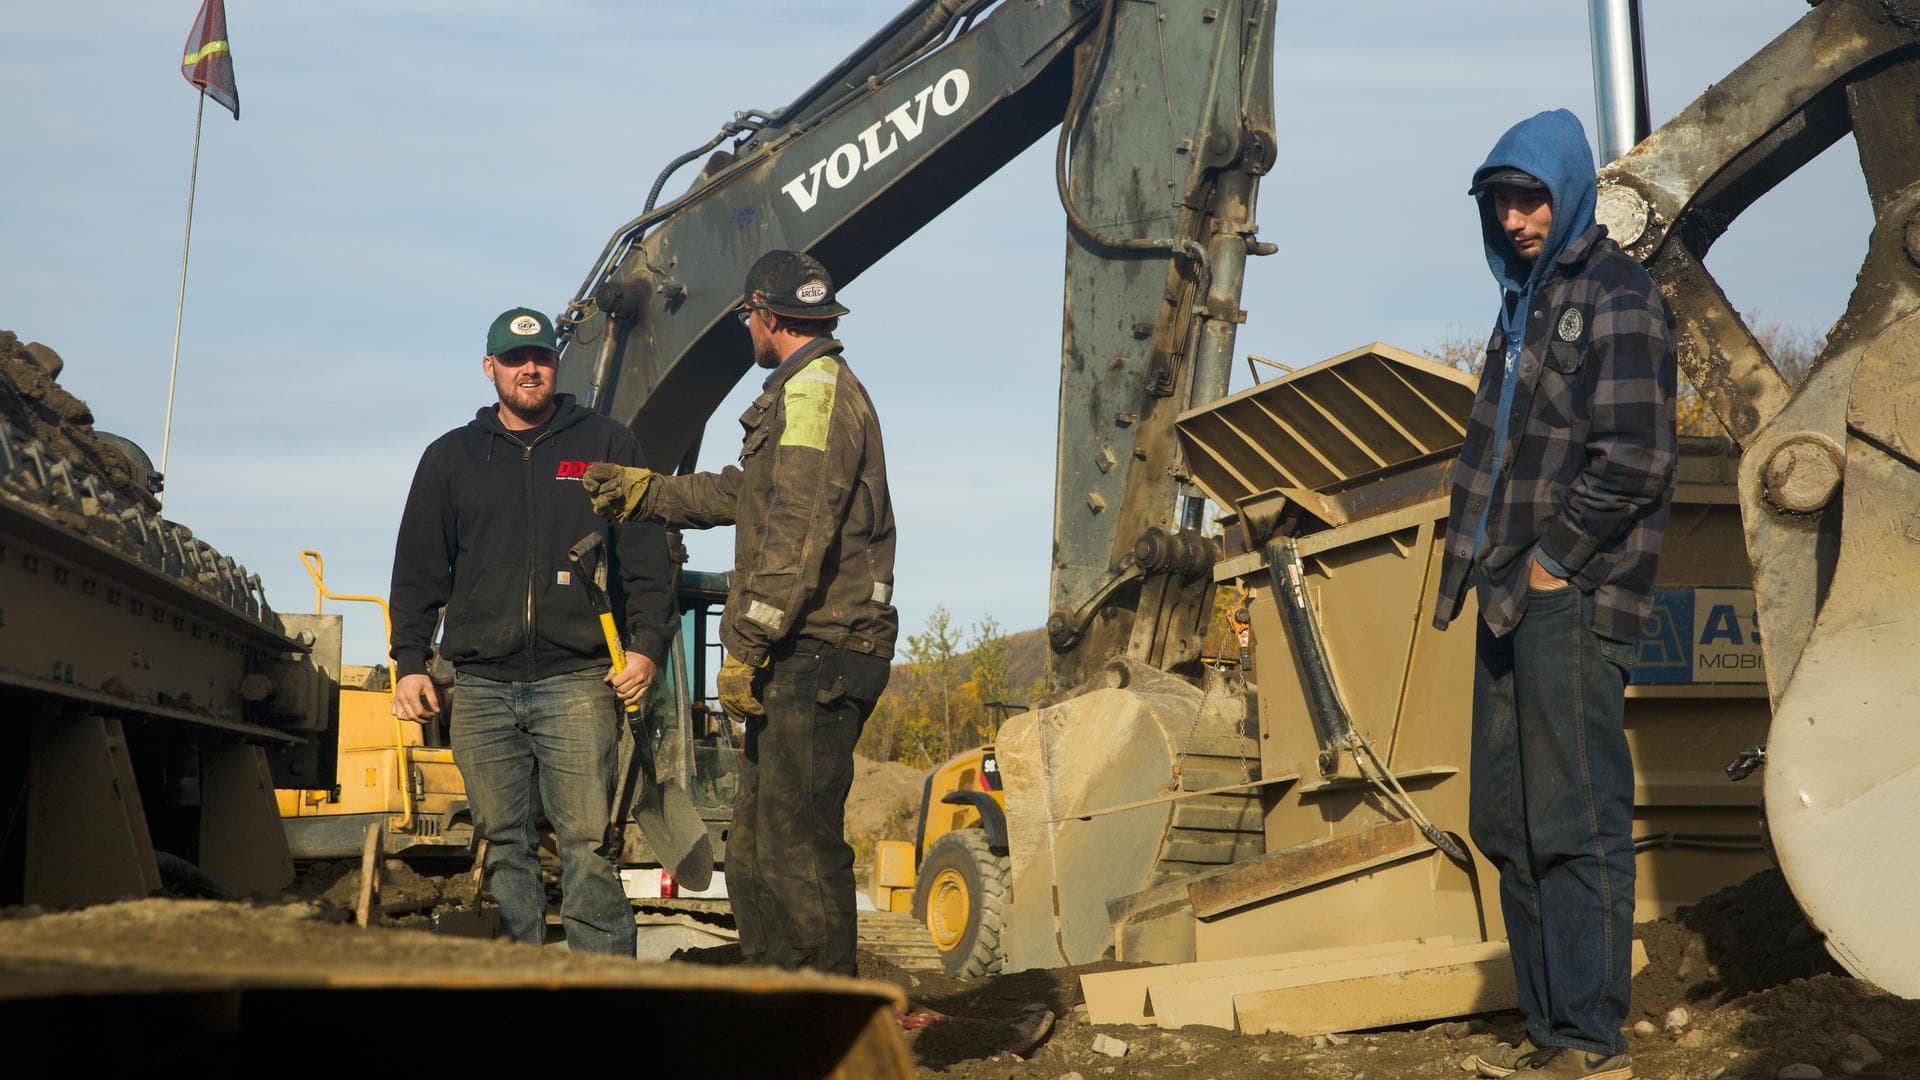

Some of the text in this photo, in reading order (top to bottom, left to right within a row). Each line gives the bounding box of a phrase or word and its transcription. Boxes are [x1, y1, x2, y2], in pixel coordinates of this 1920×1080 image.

[781, 68, 970, 213] VOLVO
[1699, 604, 1762, 645] A
[984, 759, 1000, 773] 98
